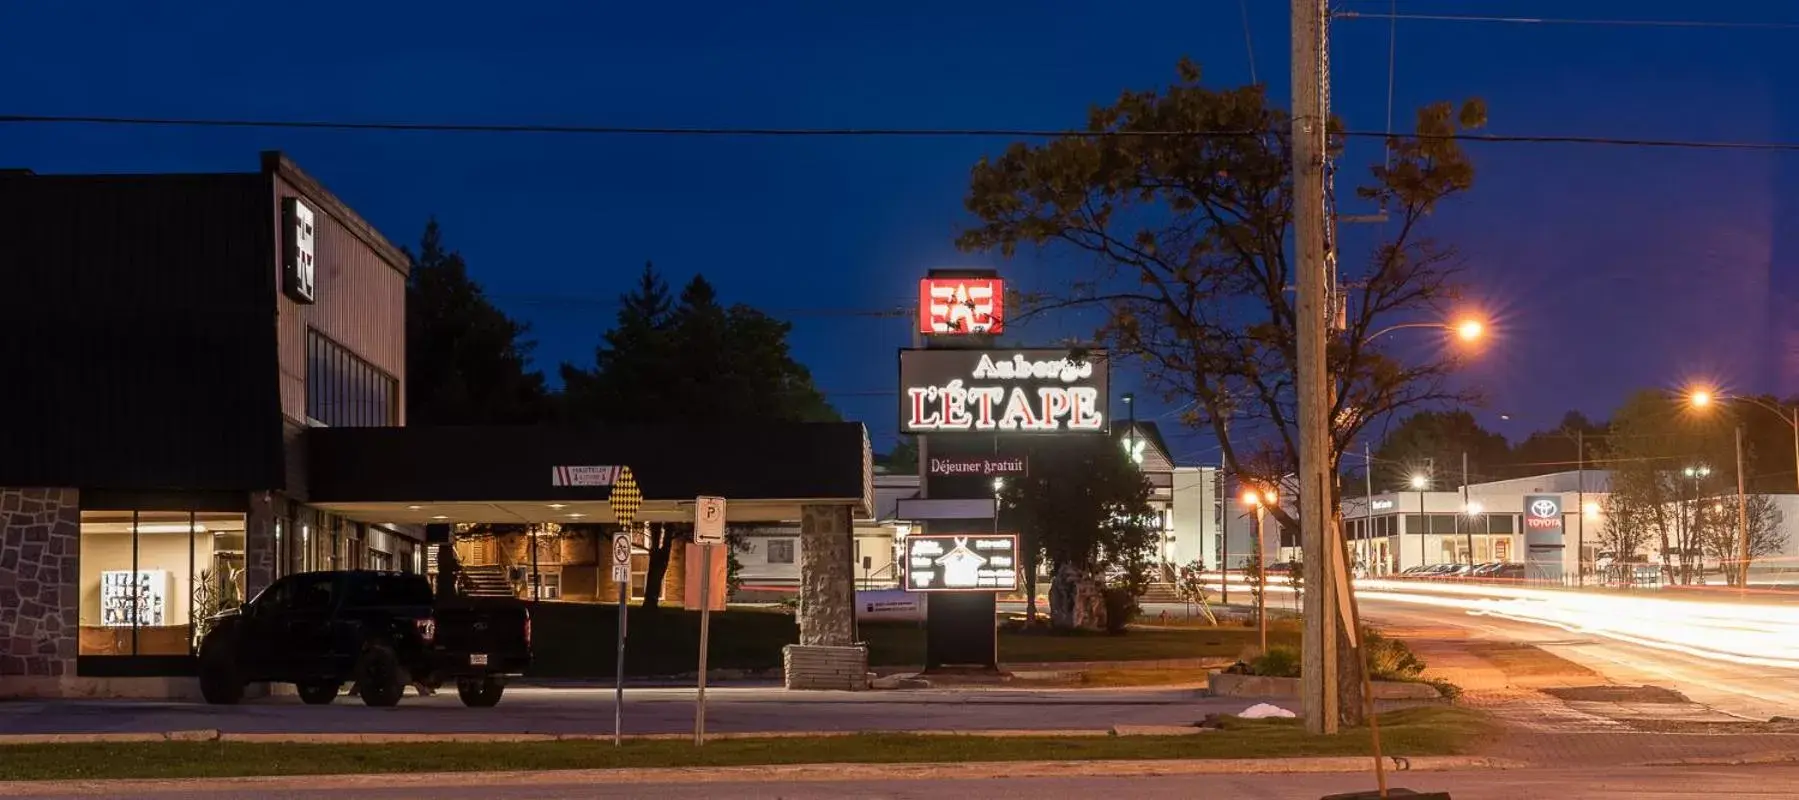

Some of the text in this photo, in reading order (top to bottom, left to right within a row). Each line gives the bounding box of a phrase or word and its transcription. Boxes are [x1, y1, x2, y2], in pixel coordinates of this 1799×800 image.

[972, 354, 1093, 382] Auberge
[908, 379, 1102, 429] L'ÉTAPE
[931, 458, 1023, 475] Déjeuner gratuit
[707, 506, 716, 518] P
[1527, 518, 1562, 529] TOYOTA
